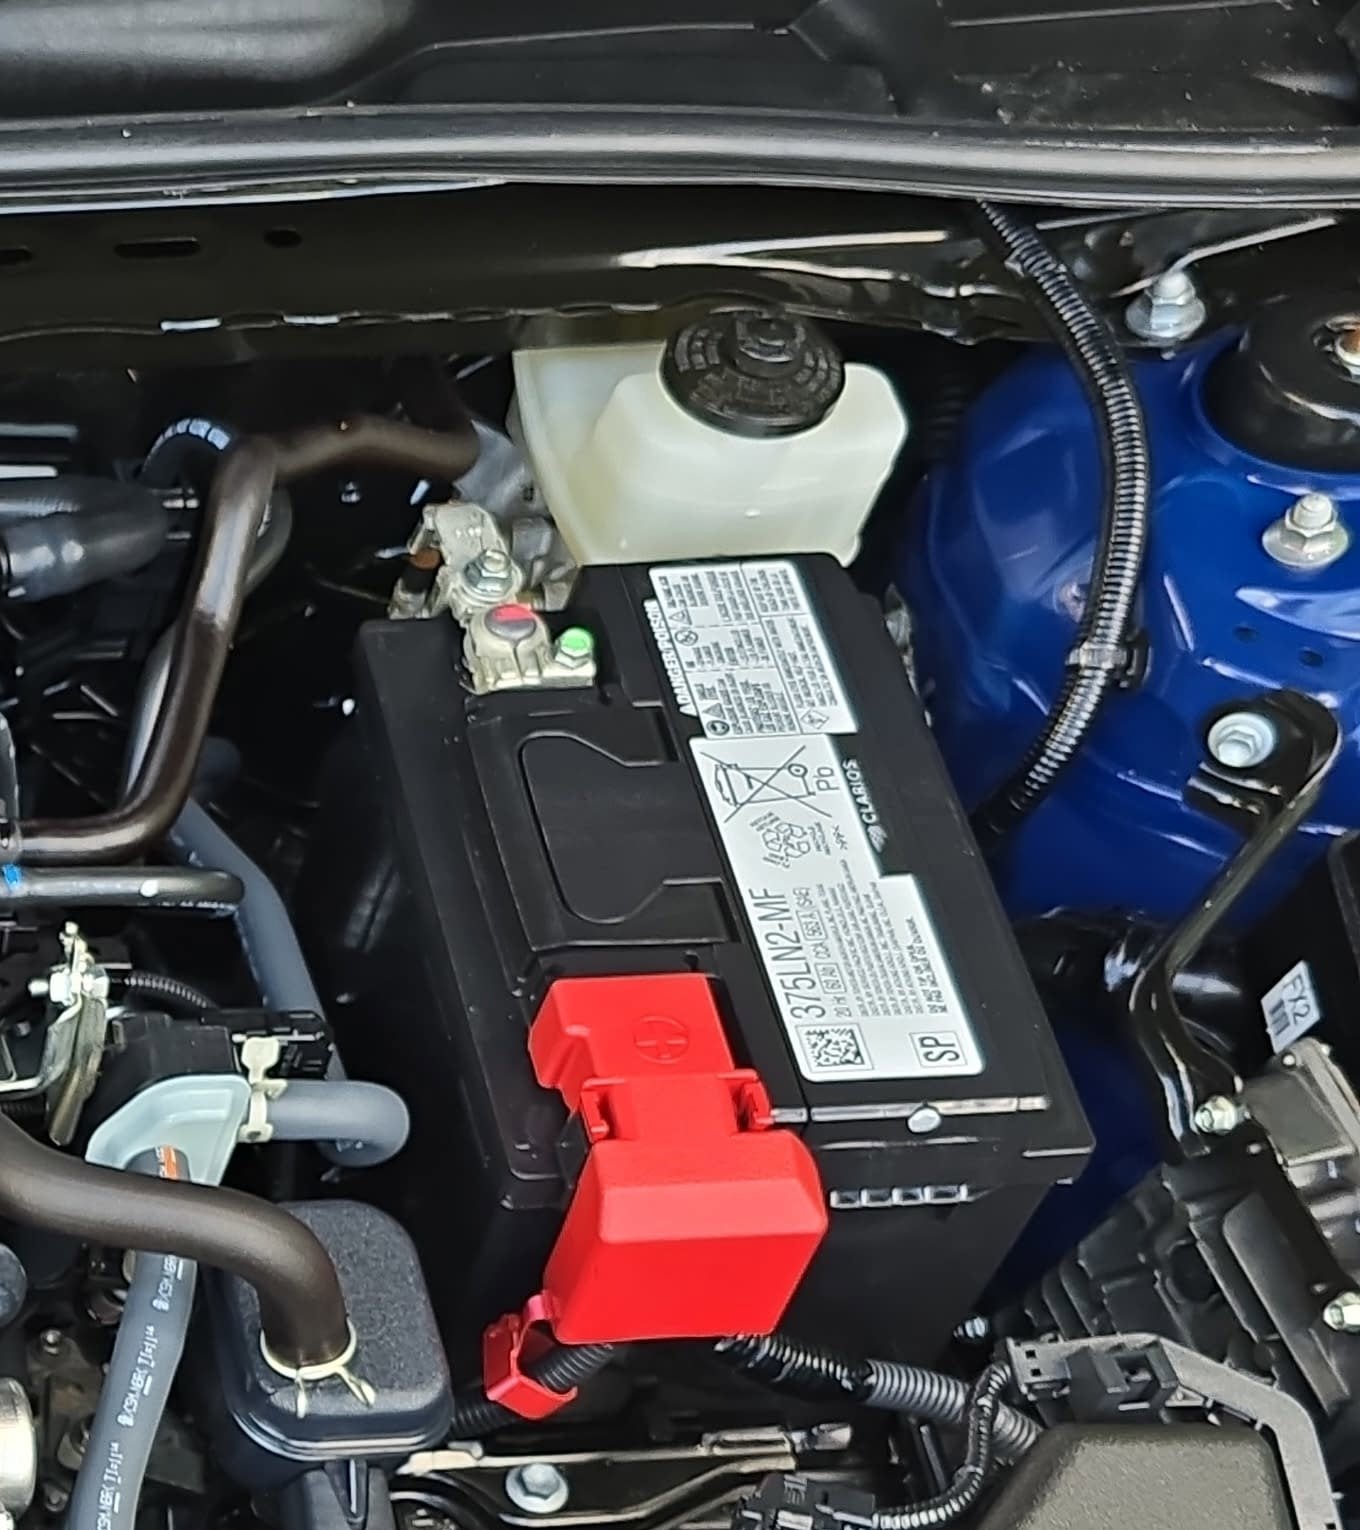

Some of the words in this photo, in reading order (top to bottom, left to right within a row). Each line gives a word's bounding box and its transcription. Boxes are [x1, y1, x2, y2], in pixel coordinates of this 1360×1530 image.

[813, 767, 840, 790] Pb
[843, 759, 878, 823] CLARIOS
[752, 888, 827, 1019] 375LN2-MF
[916, 1034, 962, 1062] SP
